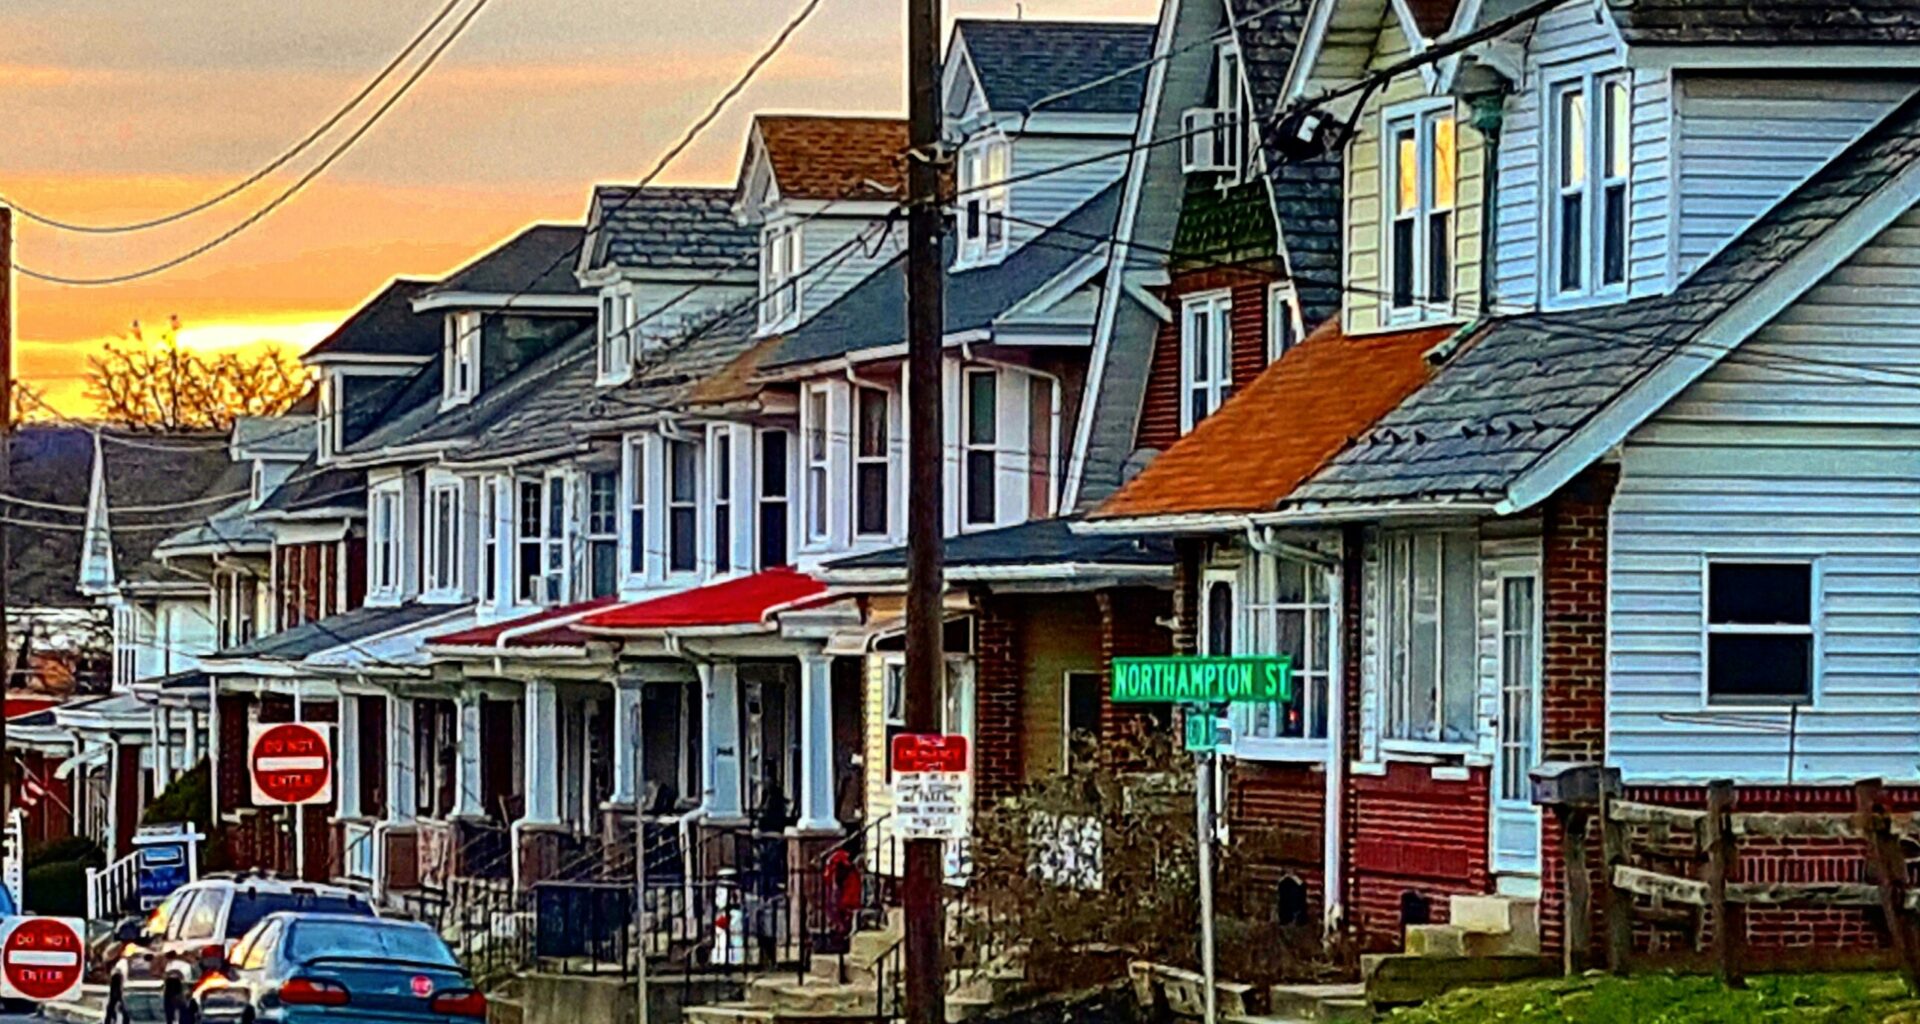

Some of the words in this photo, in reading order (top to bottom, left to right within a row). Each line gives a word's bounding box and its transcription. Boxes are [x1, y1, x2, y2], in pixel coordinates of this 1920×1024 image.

[1115, 663, 1252, 697] NORTHAMPTON
[1265, 663, 1289, 697] ST
[287, 738, 314, 753] NOT
[16, 932, 35, 947] DO
[43, 933, 71, 948] NOT
